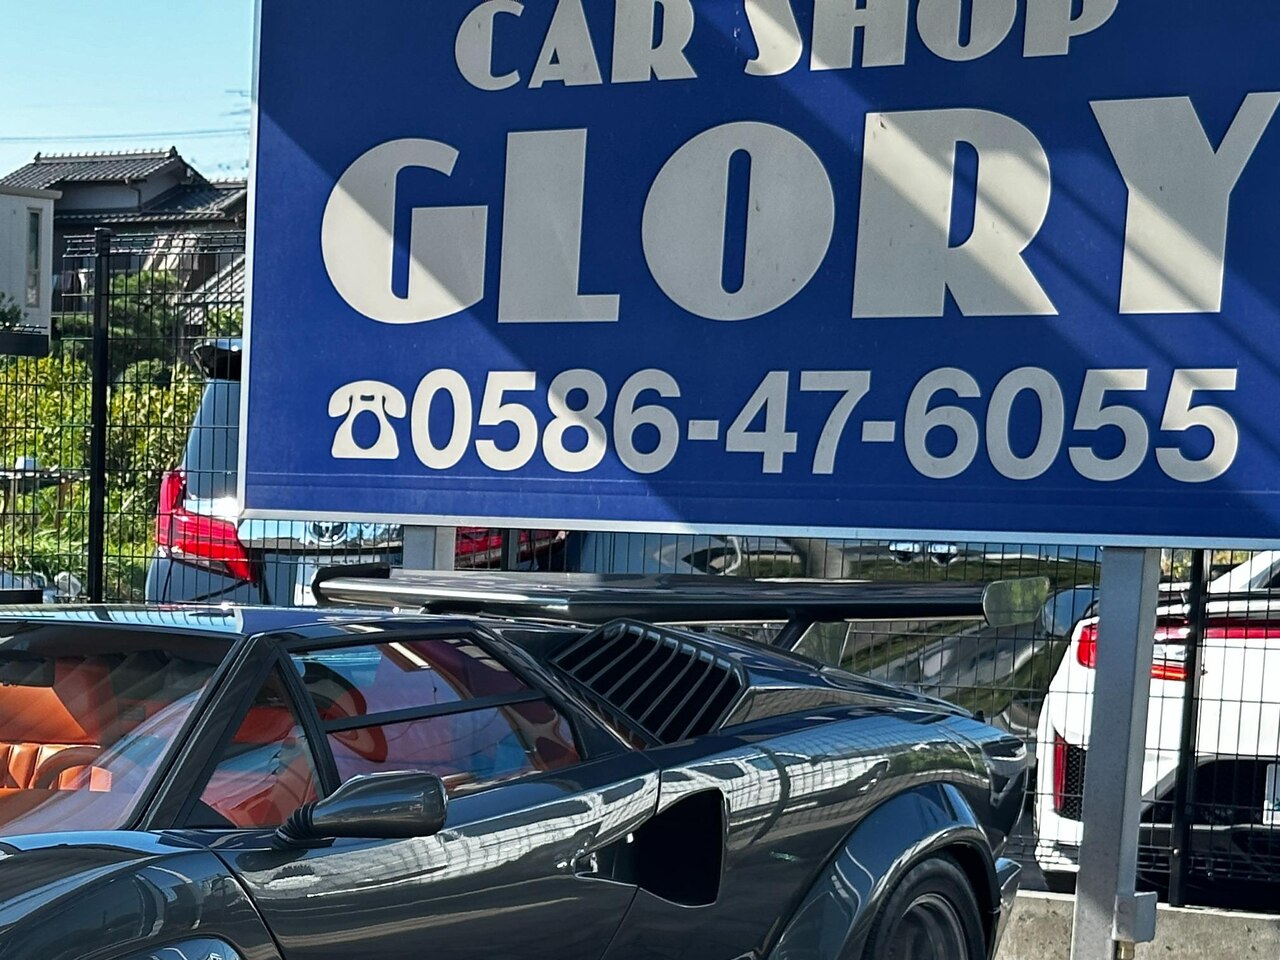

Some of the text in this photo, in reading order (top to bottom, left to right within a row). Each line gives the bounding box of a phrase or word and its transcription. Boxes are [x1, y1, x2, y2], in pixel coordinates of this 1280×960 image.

[454, 0, 1121, 91] CAR SHOP
[321, 91, 1280, 324] GLORY
[410, 366, 1239, 483] 0586-47-6055
